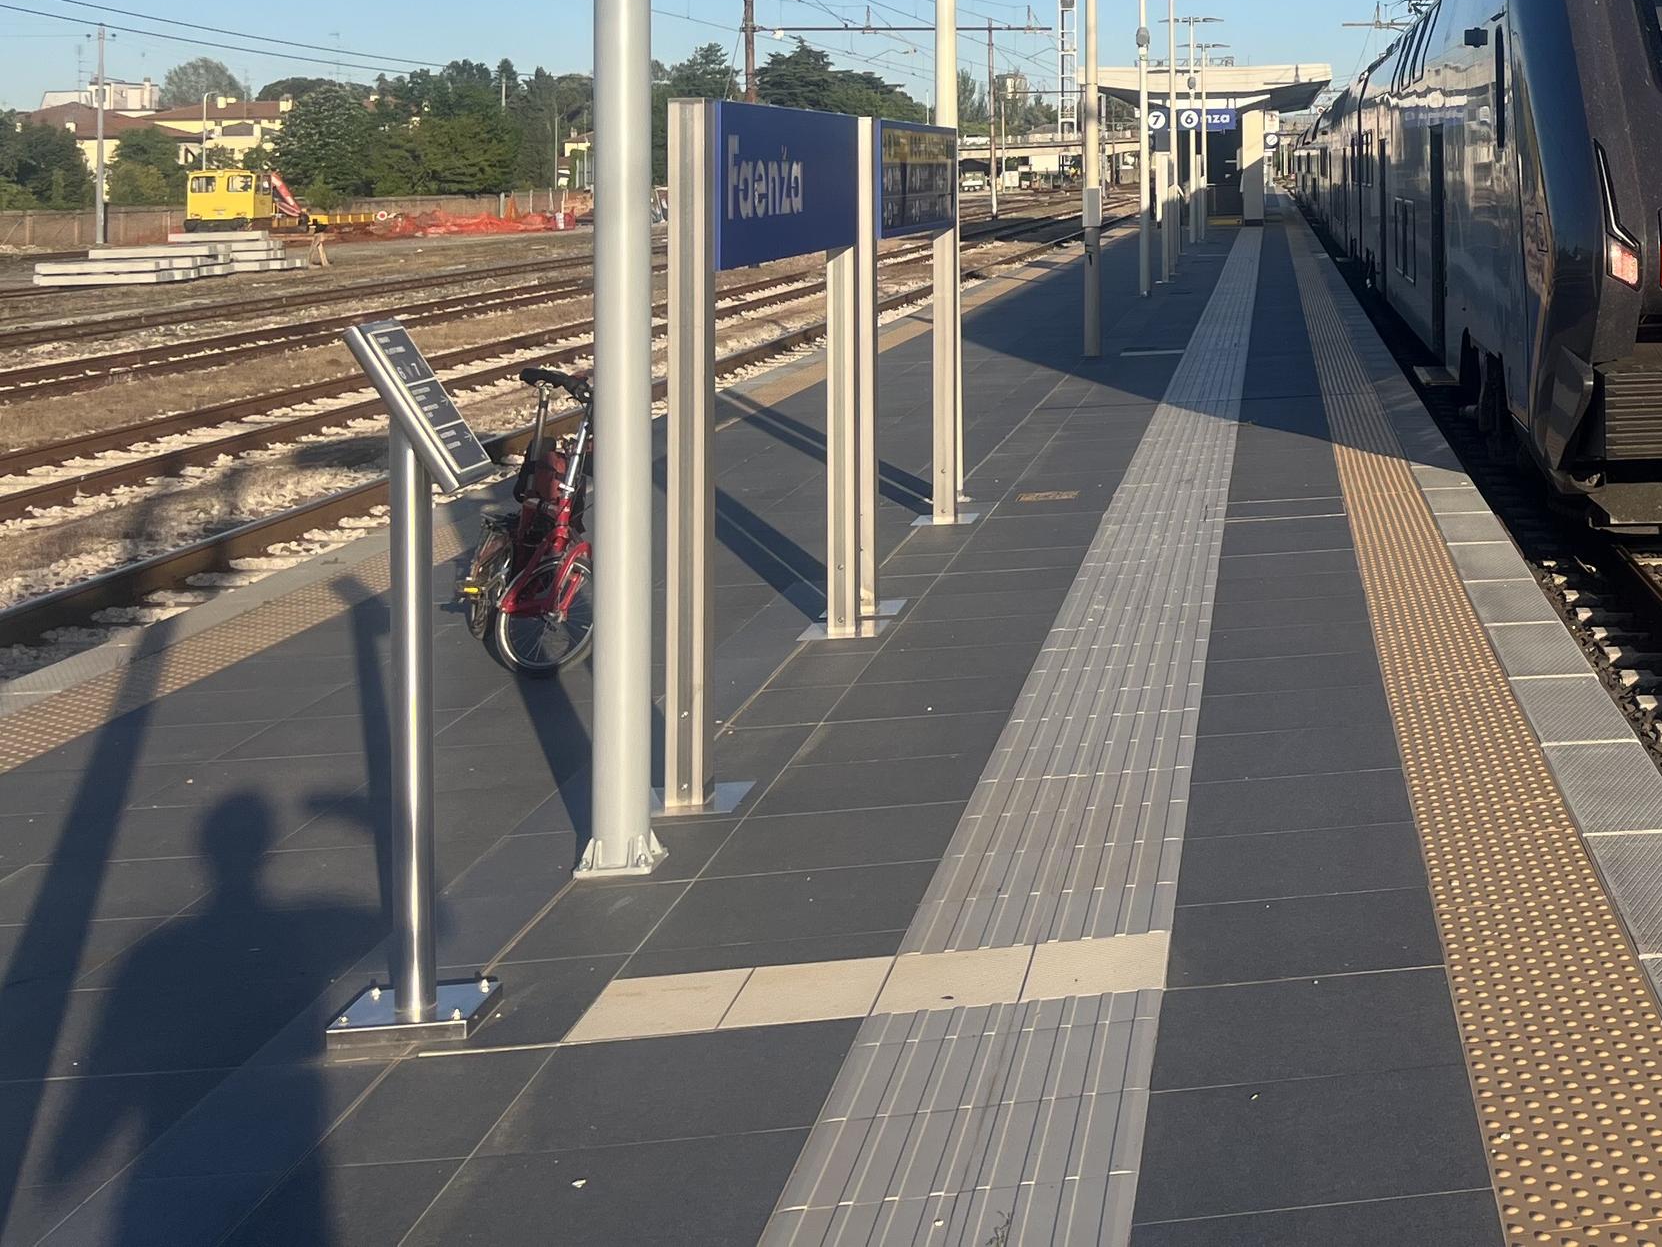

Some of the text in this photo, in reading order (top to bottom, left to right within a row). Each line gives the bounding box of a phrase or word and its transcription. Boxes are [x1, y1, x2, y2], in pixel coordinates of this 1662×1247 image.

[1152, 114, 1162, 126] 7
[1185, 113, 1194, 125] 6
[727, 134, 804, 220] Faenza
[396, 362, 421, 380] 6 7
